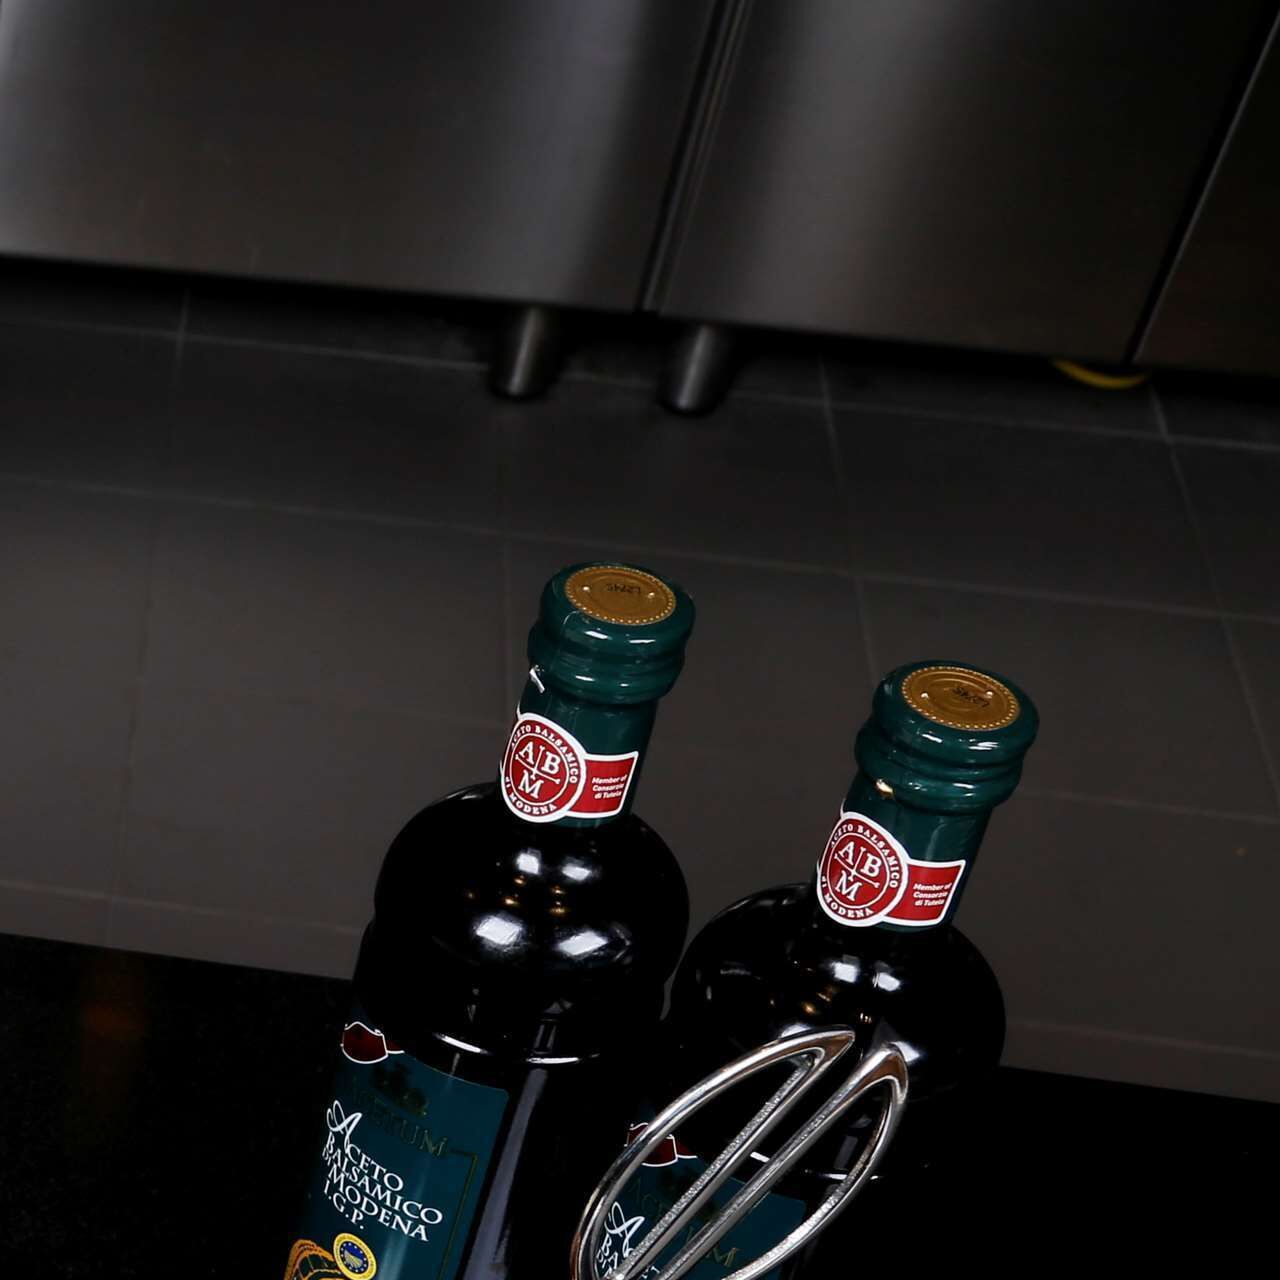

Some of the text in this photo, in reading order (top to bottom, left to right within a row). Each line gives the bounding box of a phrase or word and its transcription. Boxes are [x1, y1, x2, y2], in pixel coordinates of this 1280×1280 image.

[535, 725, 579, 784] BALSAMICO
[509, 792, 558, 815] MODENA
[857, 825, 900, 888] BALSAMICO
[824, 893, 874, 918] MODENA
[326, 1099, 404, 1192] ACETO
[326, 1131, 443, 1224] BALSAMICO
[328, 1163, 429, 1242] MODENA
